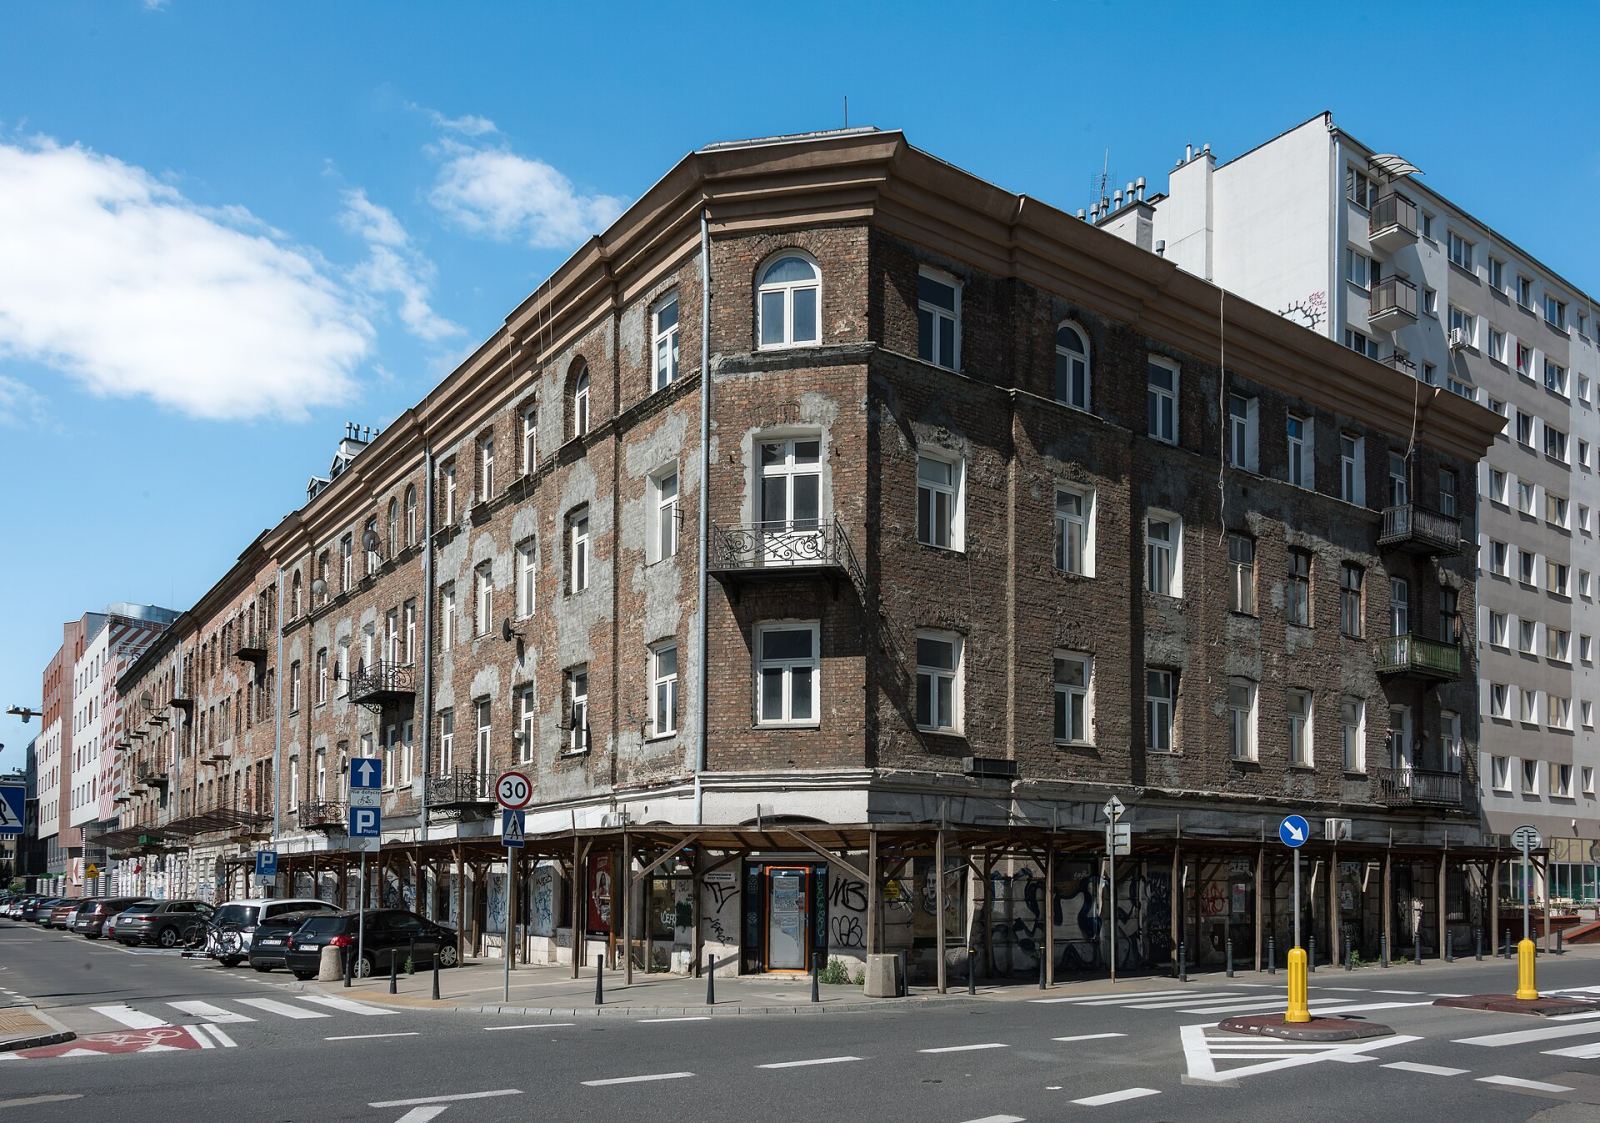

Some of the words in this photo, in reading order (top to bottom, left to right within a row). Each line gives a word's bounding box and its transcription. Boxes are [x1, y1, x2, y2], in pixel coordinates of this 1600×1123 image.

[502, 780, 526, 799] 30
[357, 810, 375, 834] P
[261, 853, 274, 868] P
